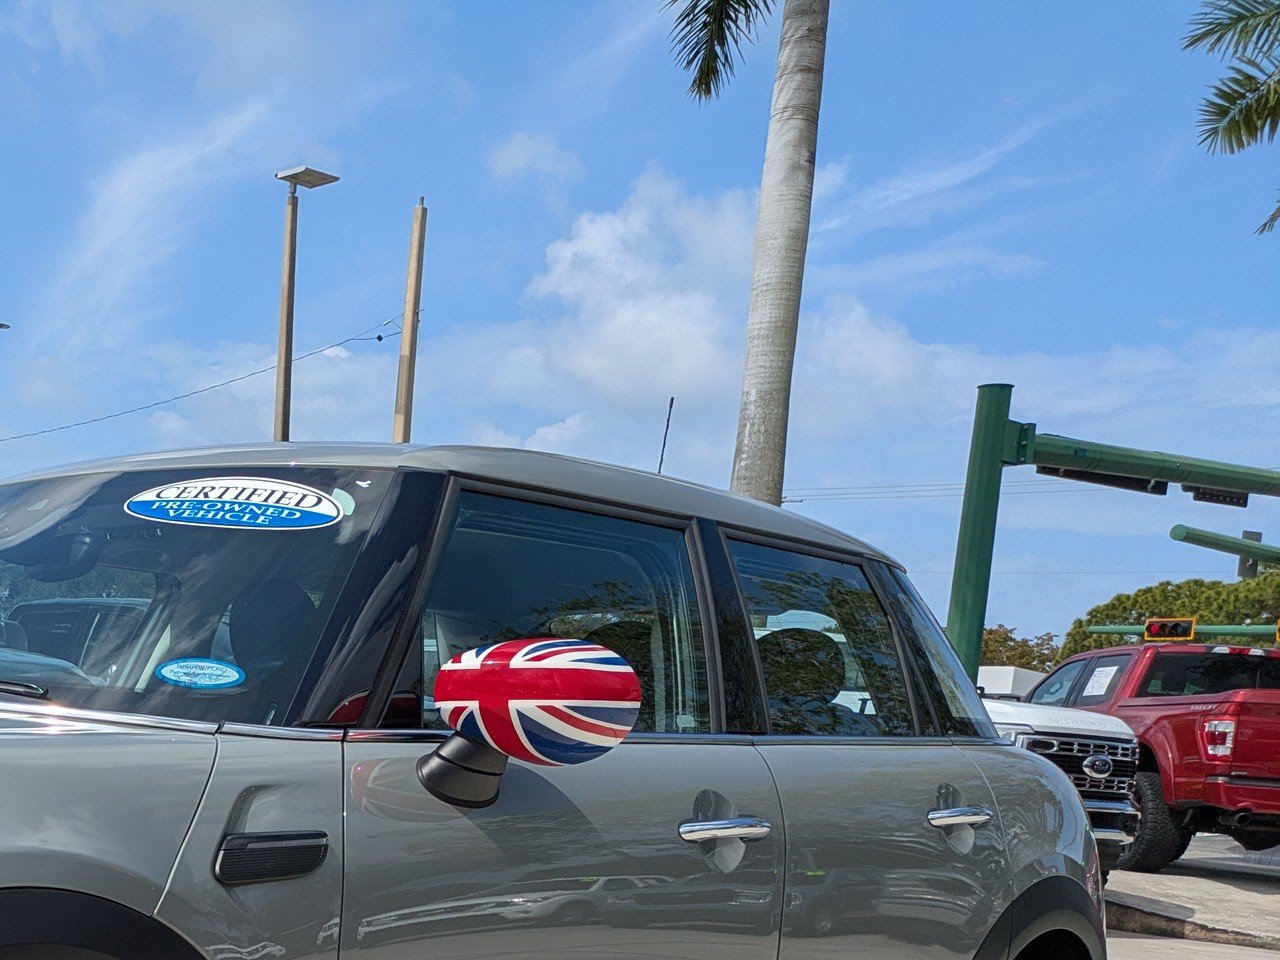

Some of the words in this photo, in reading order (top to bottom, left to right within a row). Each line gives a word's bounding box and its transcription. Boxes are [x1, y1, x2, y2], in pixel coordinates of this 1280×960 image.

[155, 486, 323, 509] CERTIFIED
[150, 501, 302, 519] PRE-OWNED
[168, 510, 271, 525] VEHICLE
